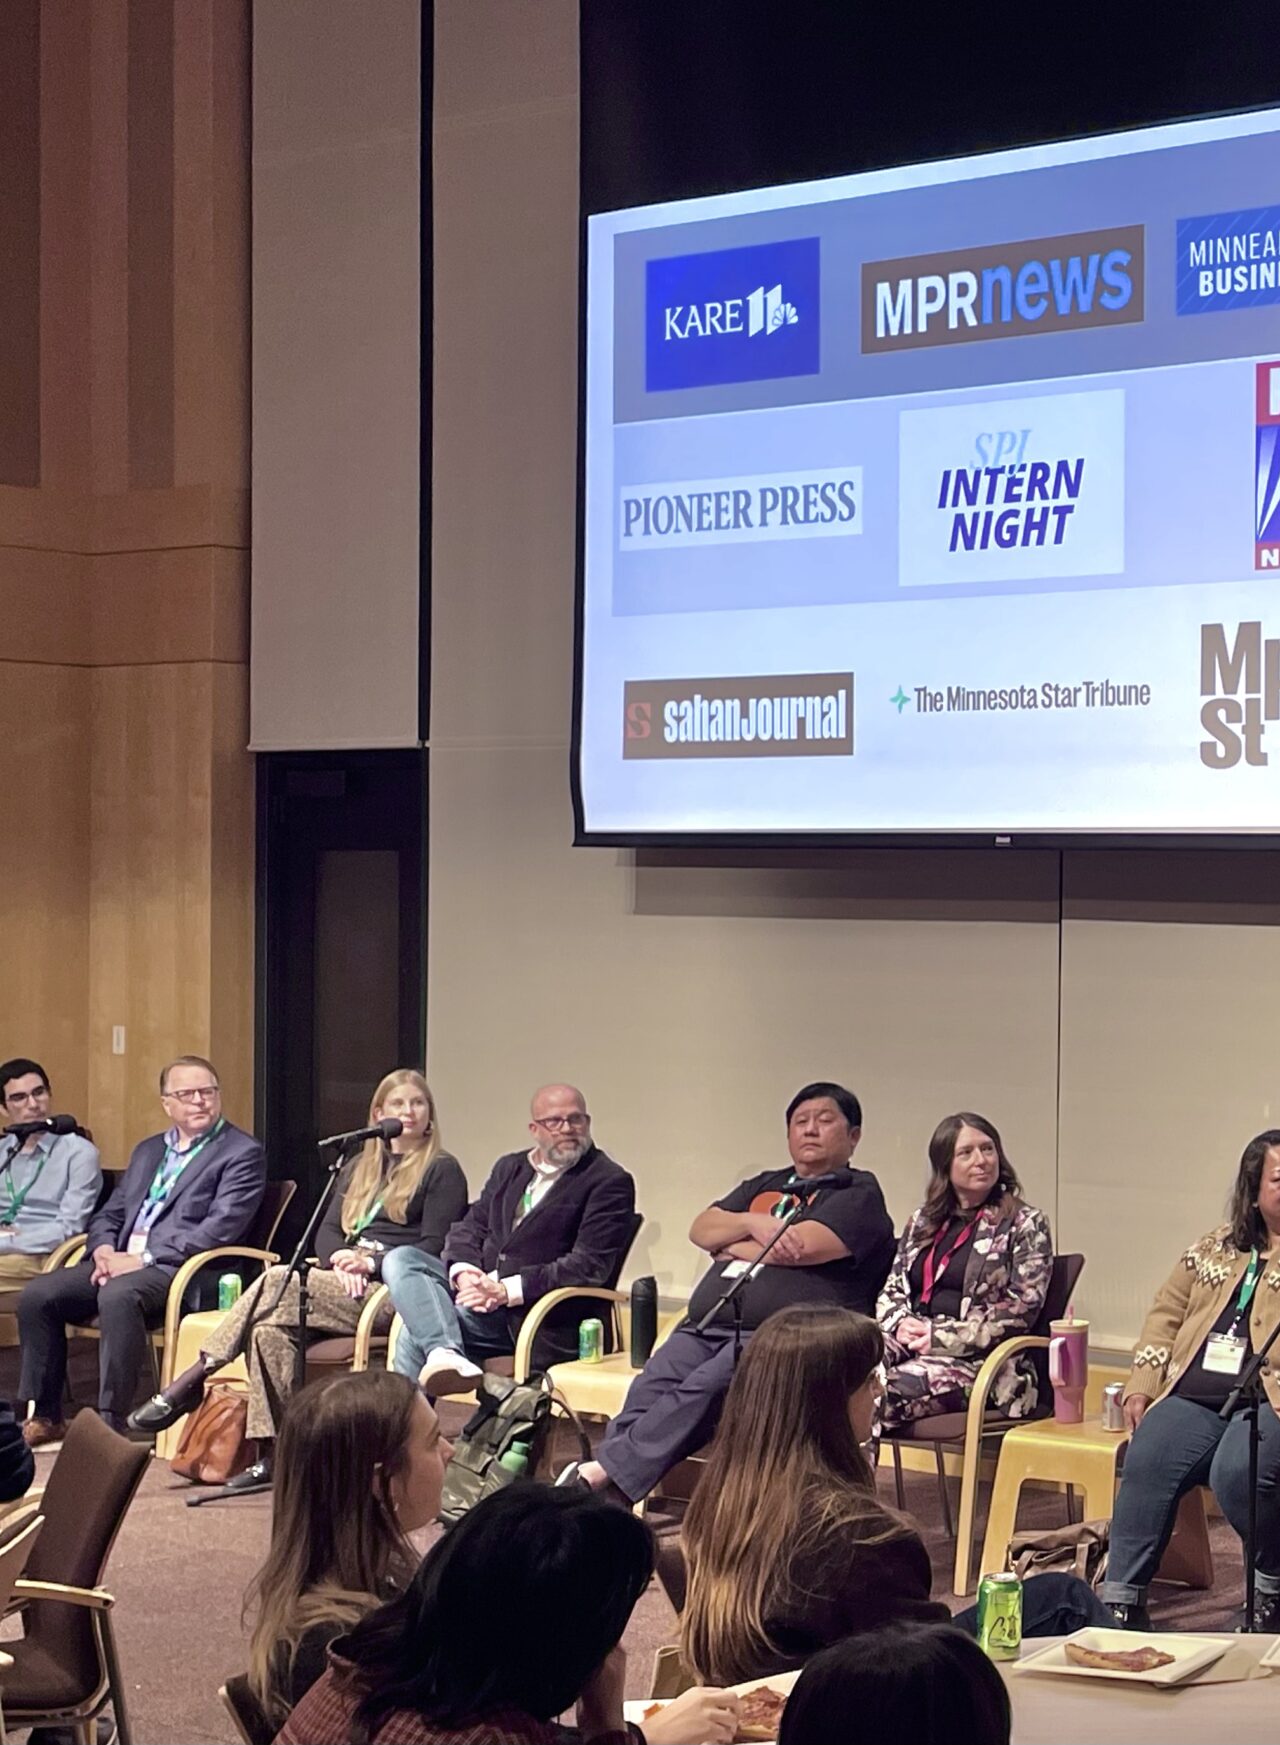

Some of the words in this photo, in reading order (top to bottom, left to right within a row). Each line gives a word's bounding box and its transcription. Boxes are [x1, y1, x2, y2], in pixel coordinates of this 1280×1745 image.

[623, 488, 753, 537] PIONEER
[758, 480, 856, 527] PRESS
[938, 458, 1085, 509] INTERN
[949, 504, 1075, 552] NIGHT
[914, 686, 944, 712] The
[946, 684, 1038, 711] Minnesota
[1040, 682, 1081, 708] Star
[1082, 679, 1151, 707] Tribune
[1200, 697, 1268, 769] St
